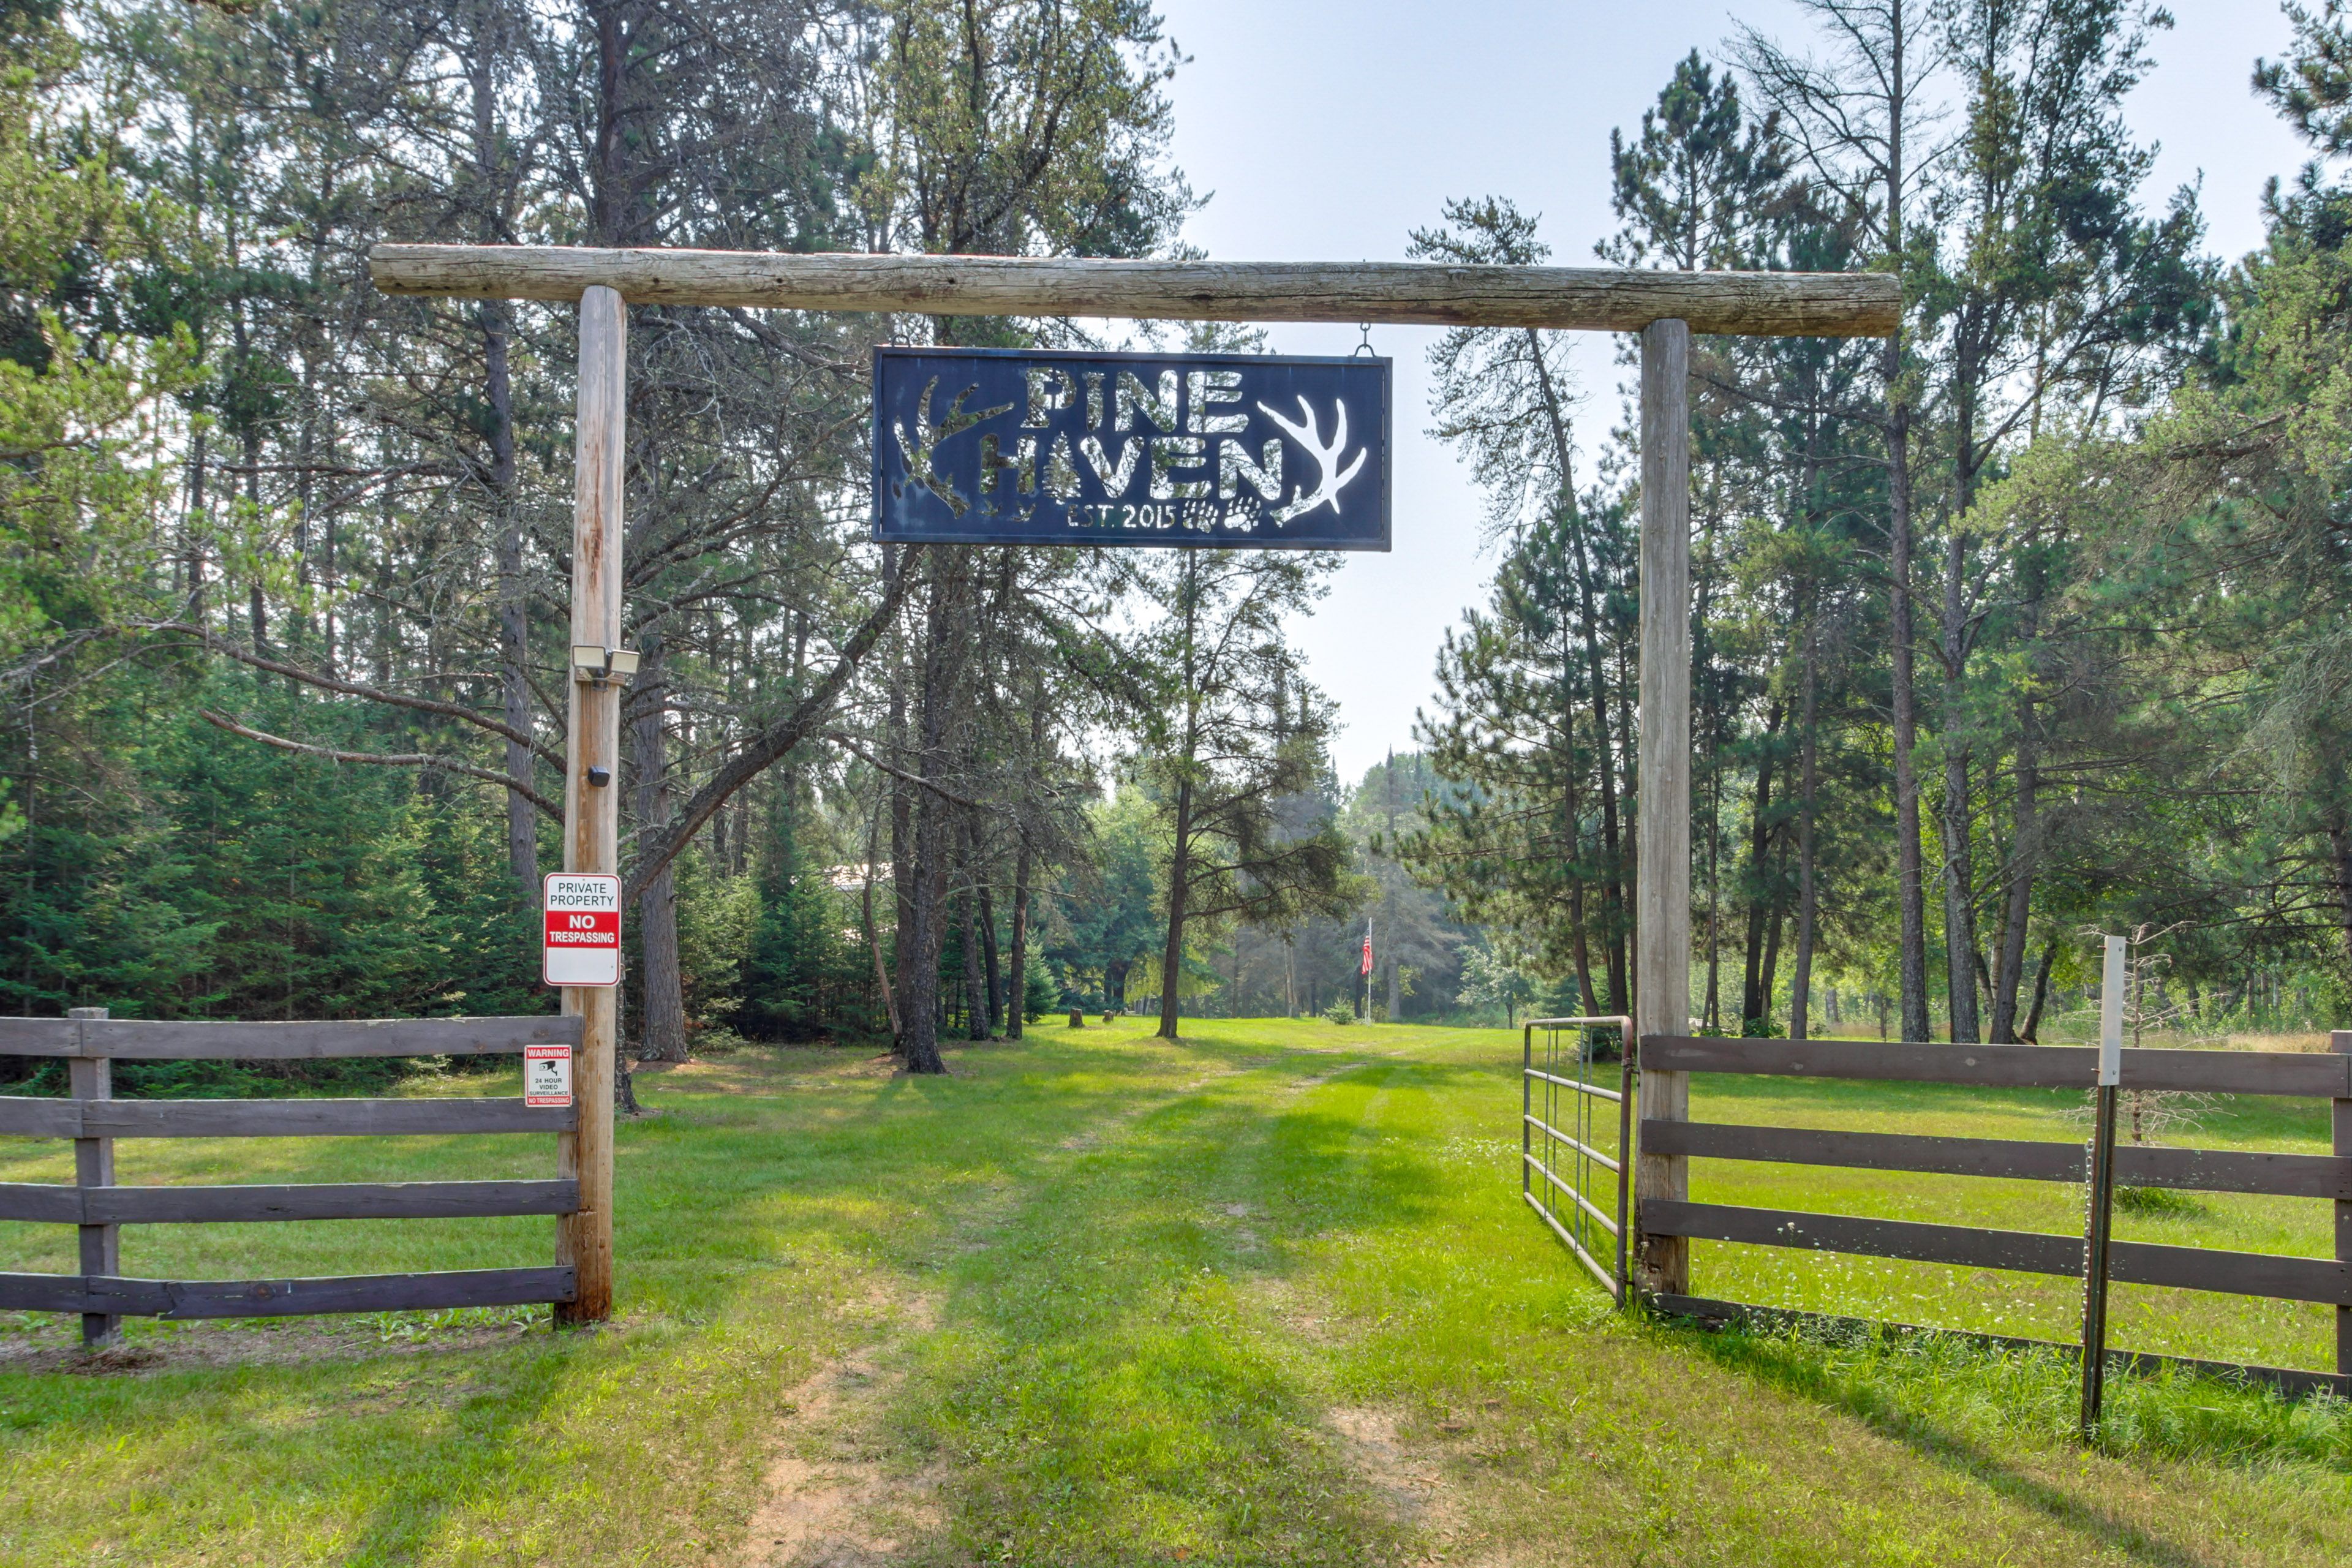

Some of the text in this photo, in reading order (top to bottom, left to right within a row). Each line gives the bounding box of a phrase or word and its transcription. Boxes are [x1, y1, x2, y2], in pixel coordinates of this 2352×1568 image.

[1020, 368, 1249, 432] PINE
[1067, 504, 1176, 529] EST. 2015
[558, 883, 606, 894] PRIVATE
[550, 895, 614, 907] PROPERTY
[569, 914, 595, 929] NO
[549, 931, 615, 943] TRESPASSING
[527, 1049, 569, 1058] WARNING
